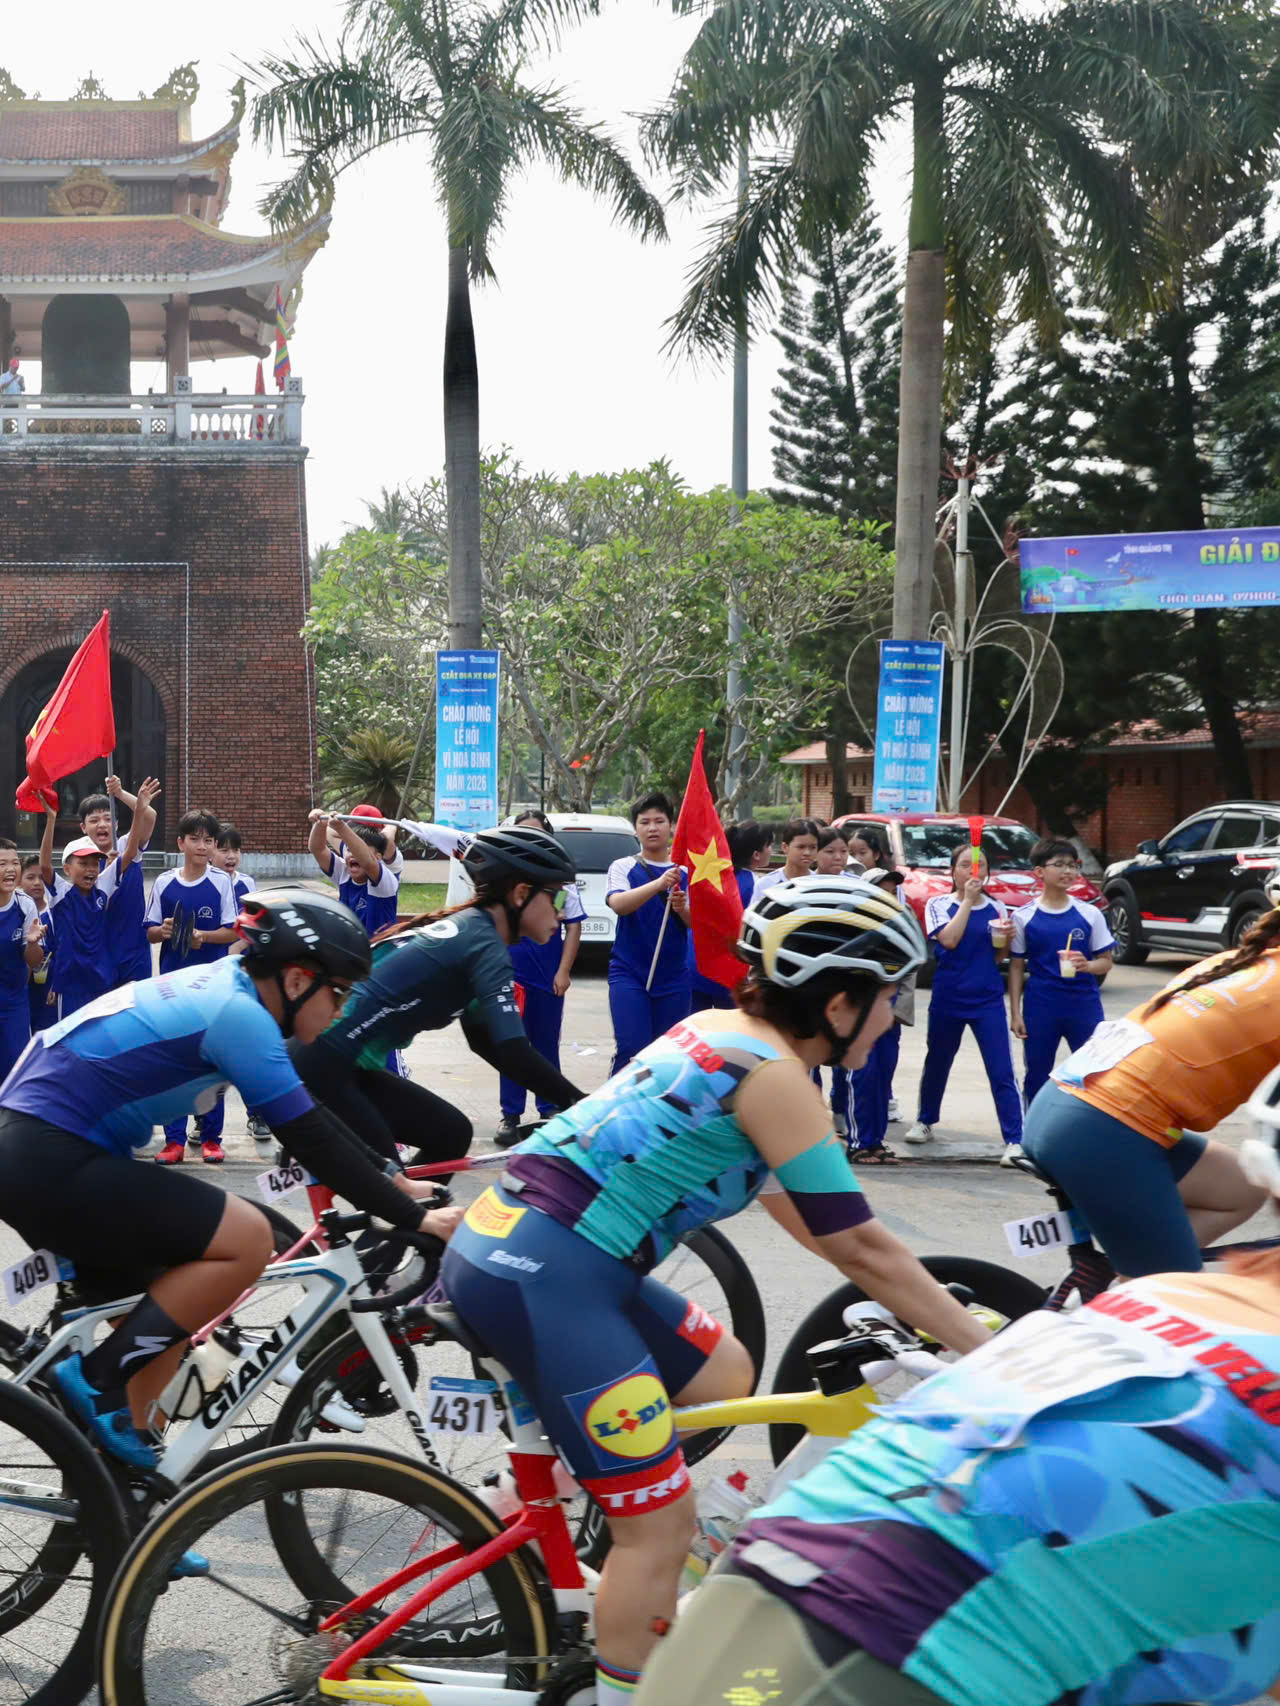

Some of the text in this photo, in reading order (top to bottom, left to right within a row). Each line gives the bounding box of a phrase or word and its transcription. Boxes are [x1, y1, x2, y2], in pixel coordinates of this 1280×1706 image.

[1200, 537, 1253, 565] GIẢI
[443, 702, 491, 722] CHÀO MỪNG
[268, 1165, 304, 1194] 426
[1019, 1215, 1062, 1251] 401
[12, 1260, 51, 1296] 409
[202, 1315, 297, 1430] GIANT
[430, 1395, 487, 1433] 431
